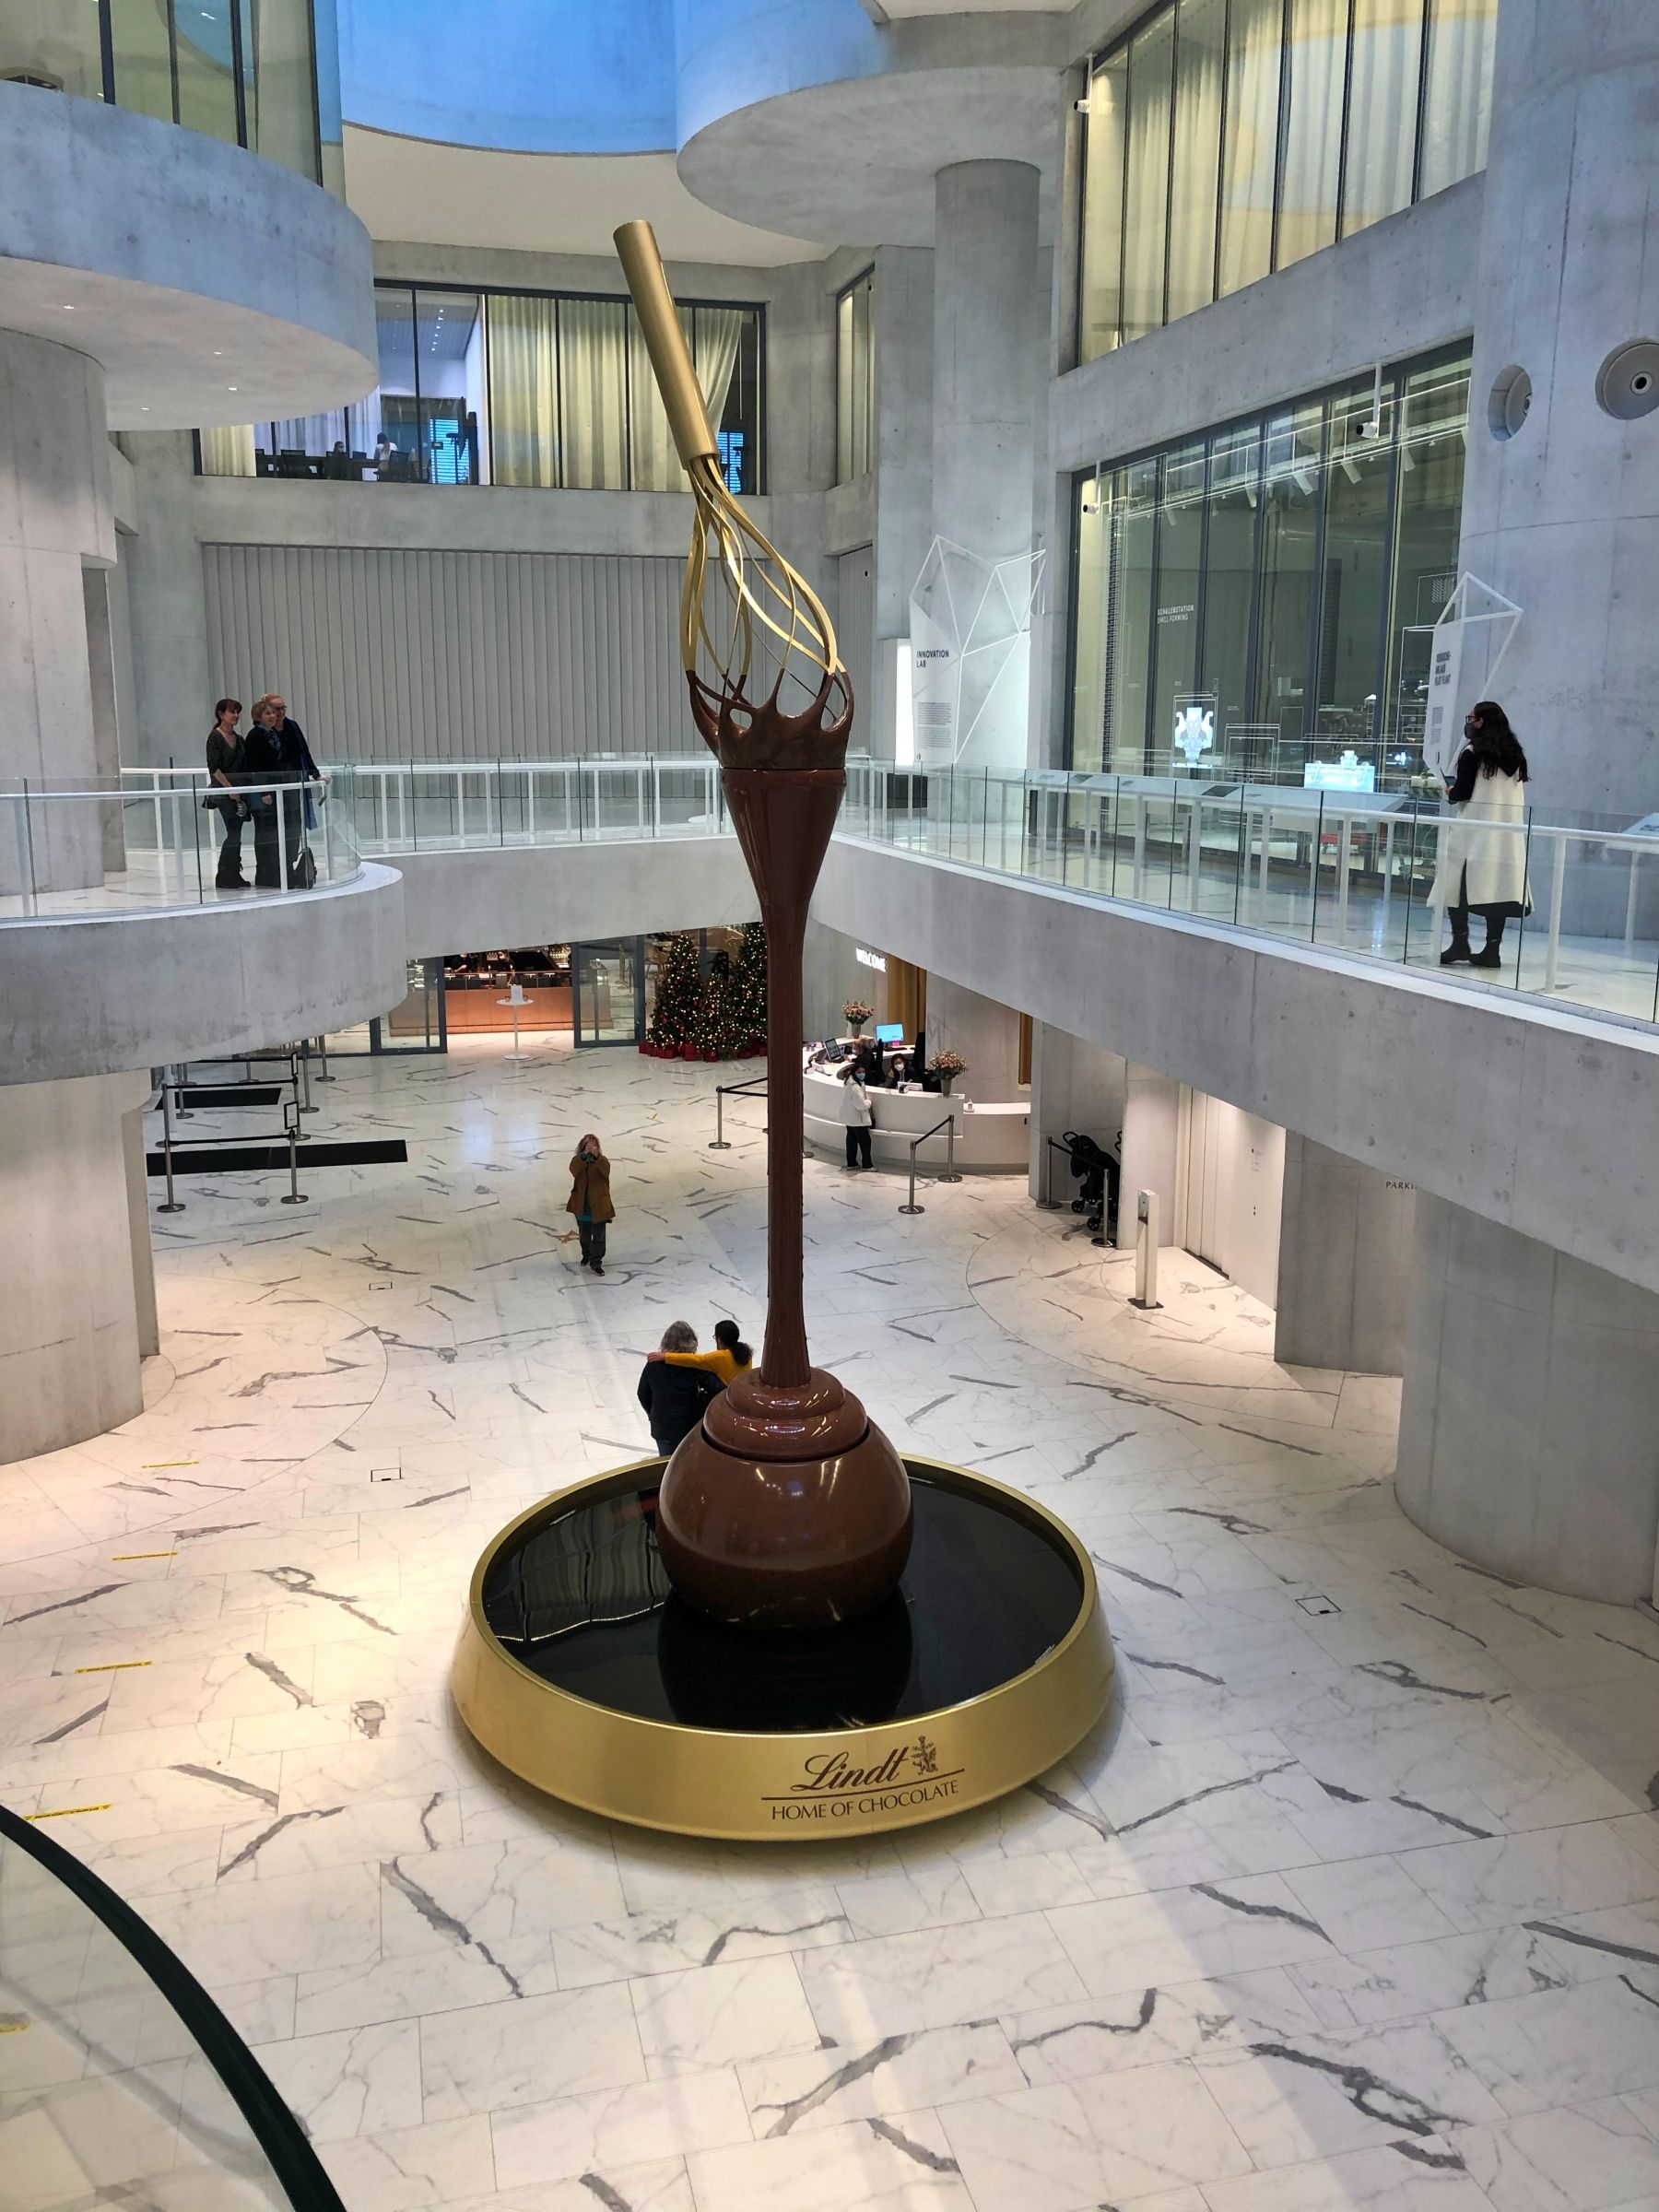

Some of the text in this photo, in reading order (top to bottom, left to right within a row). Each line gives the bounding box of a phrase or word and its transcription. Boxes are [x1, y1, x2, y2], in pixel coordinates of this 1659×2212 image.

[916, 650, 949, 658] INNOVATION
[916, 660, 926, 668] LAB
[855, 947, 887, 972] WELCOME
[790, 1746, 910, 1792] Lindt
[771, 1779, 959, 1820] HOME OF CHOCOLATE
